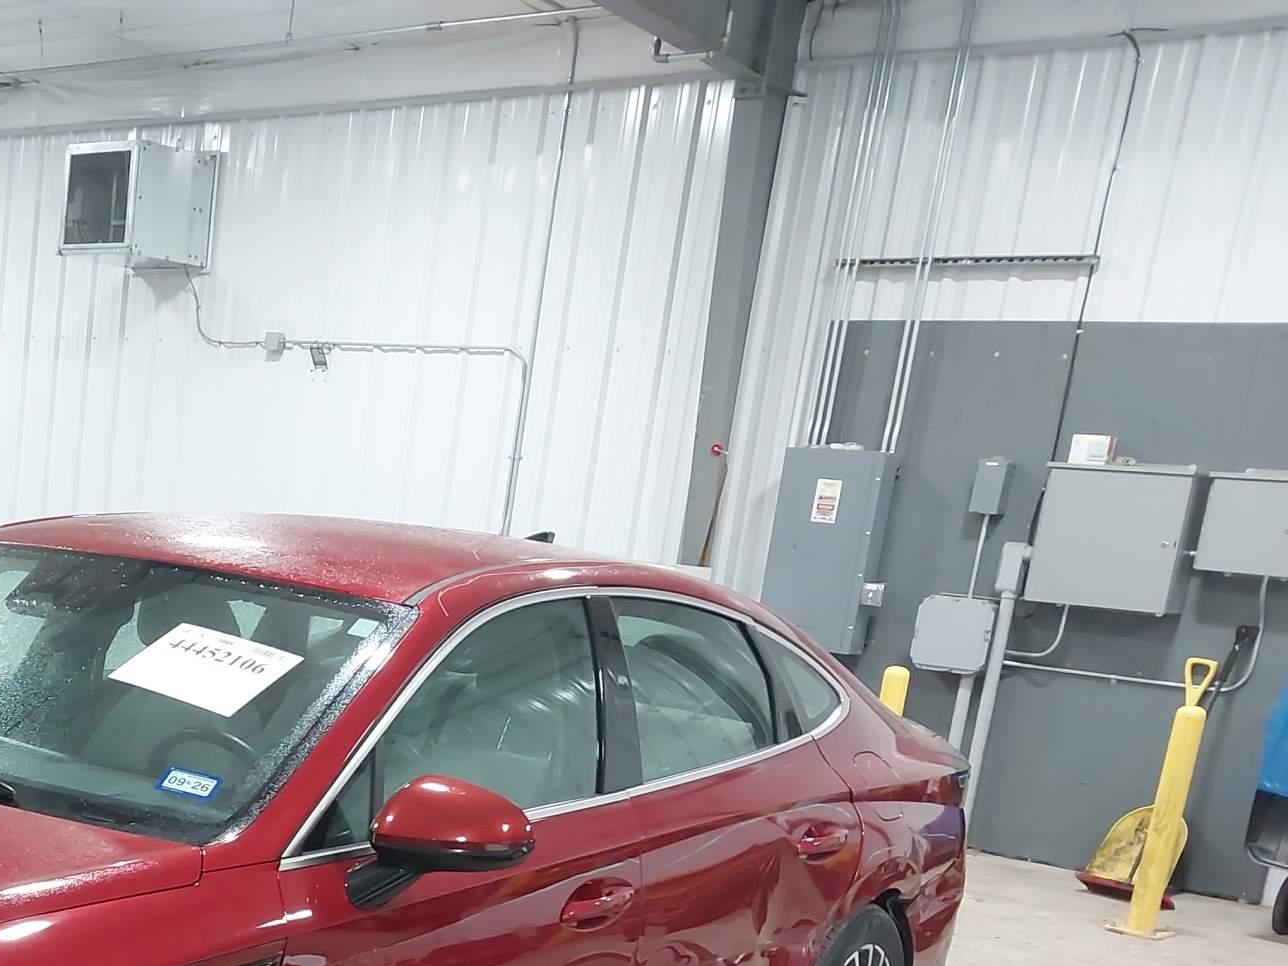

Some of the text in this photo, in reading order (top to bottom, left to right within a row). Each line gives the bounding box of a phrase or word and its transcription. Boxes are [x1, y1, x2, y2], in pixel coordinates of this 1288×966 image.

[169, 639, 268, 674] 44452106
[168, 776, 211, 792] 09 26
